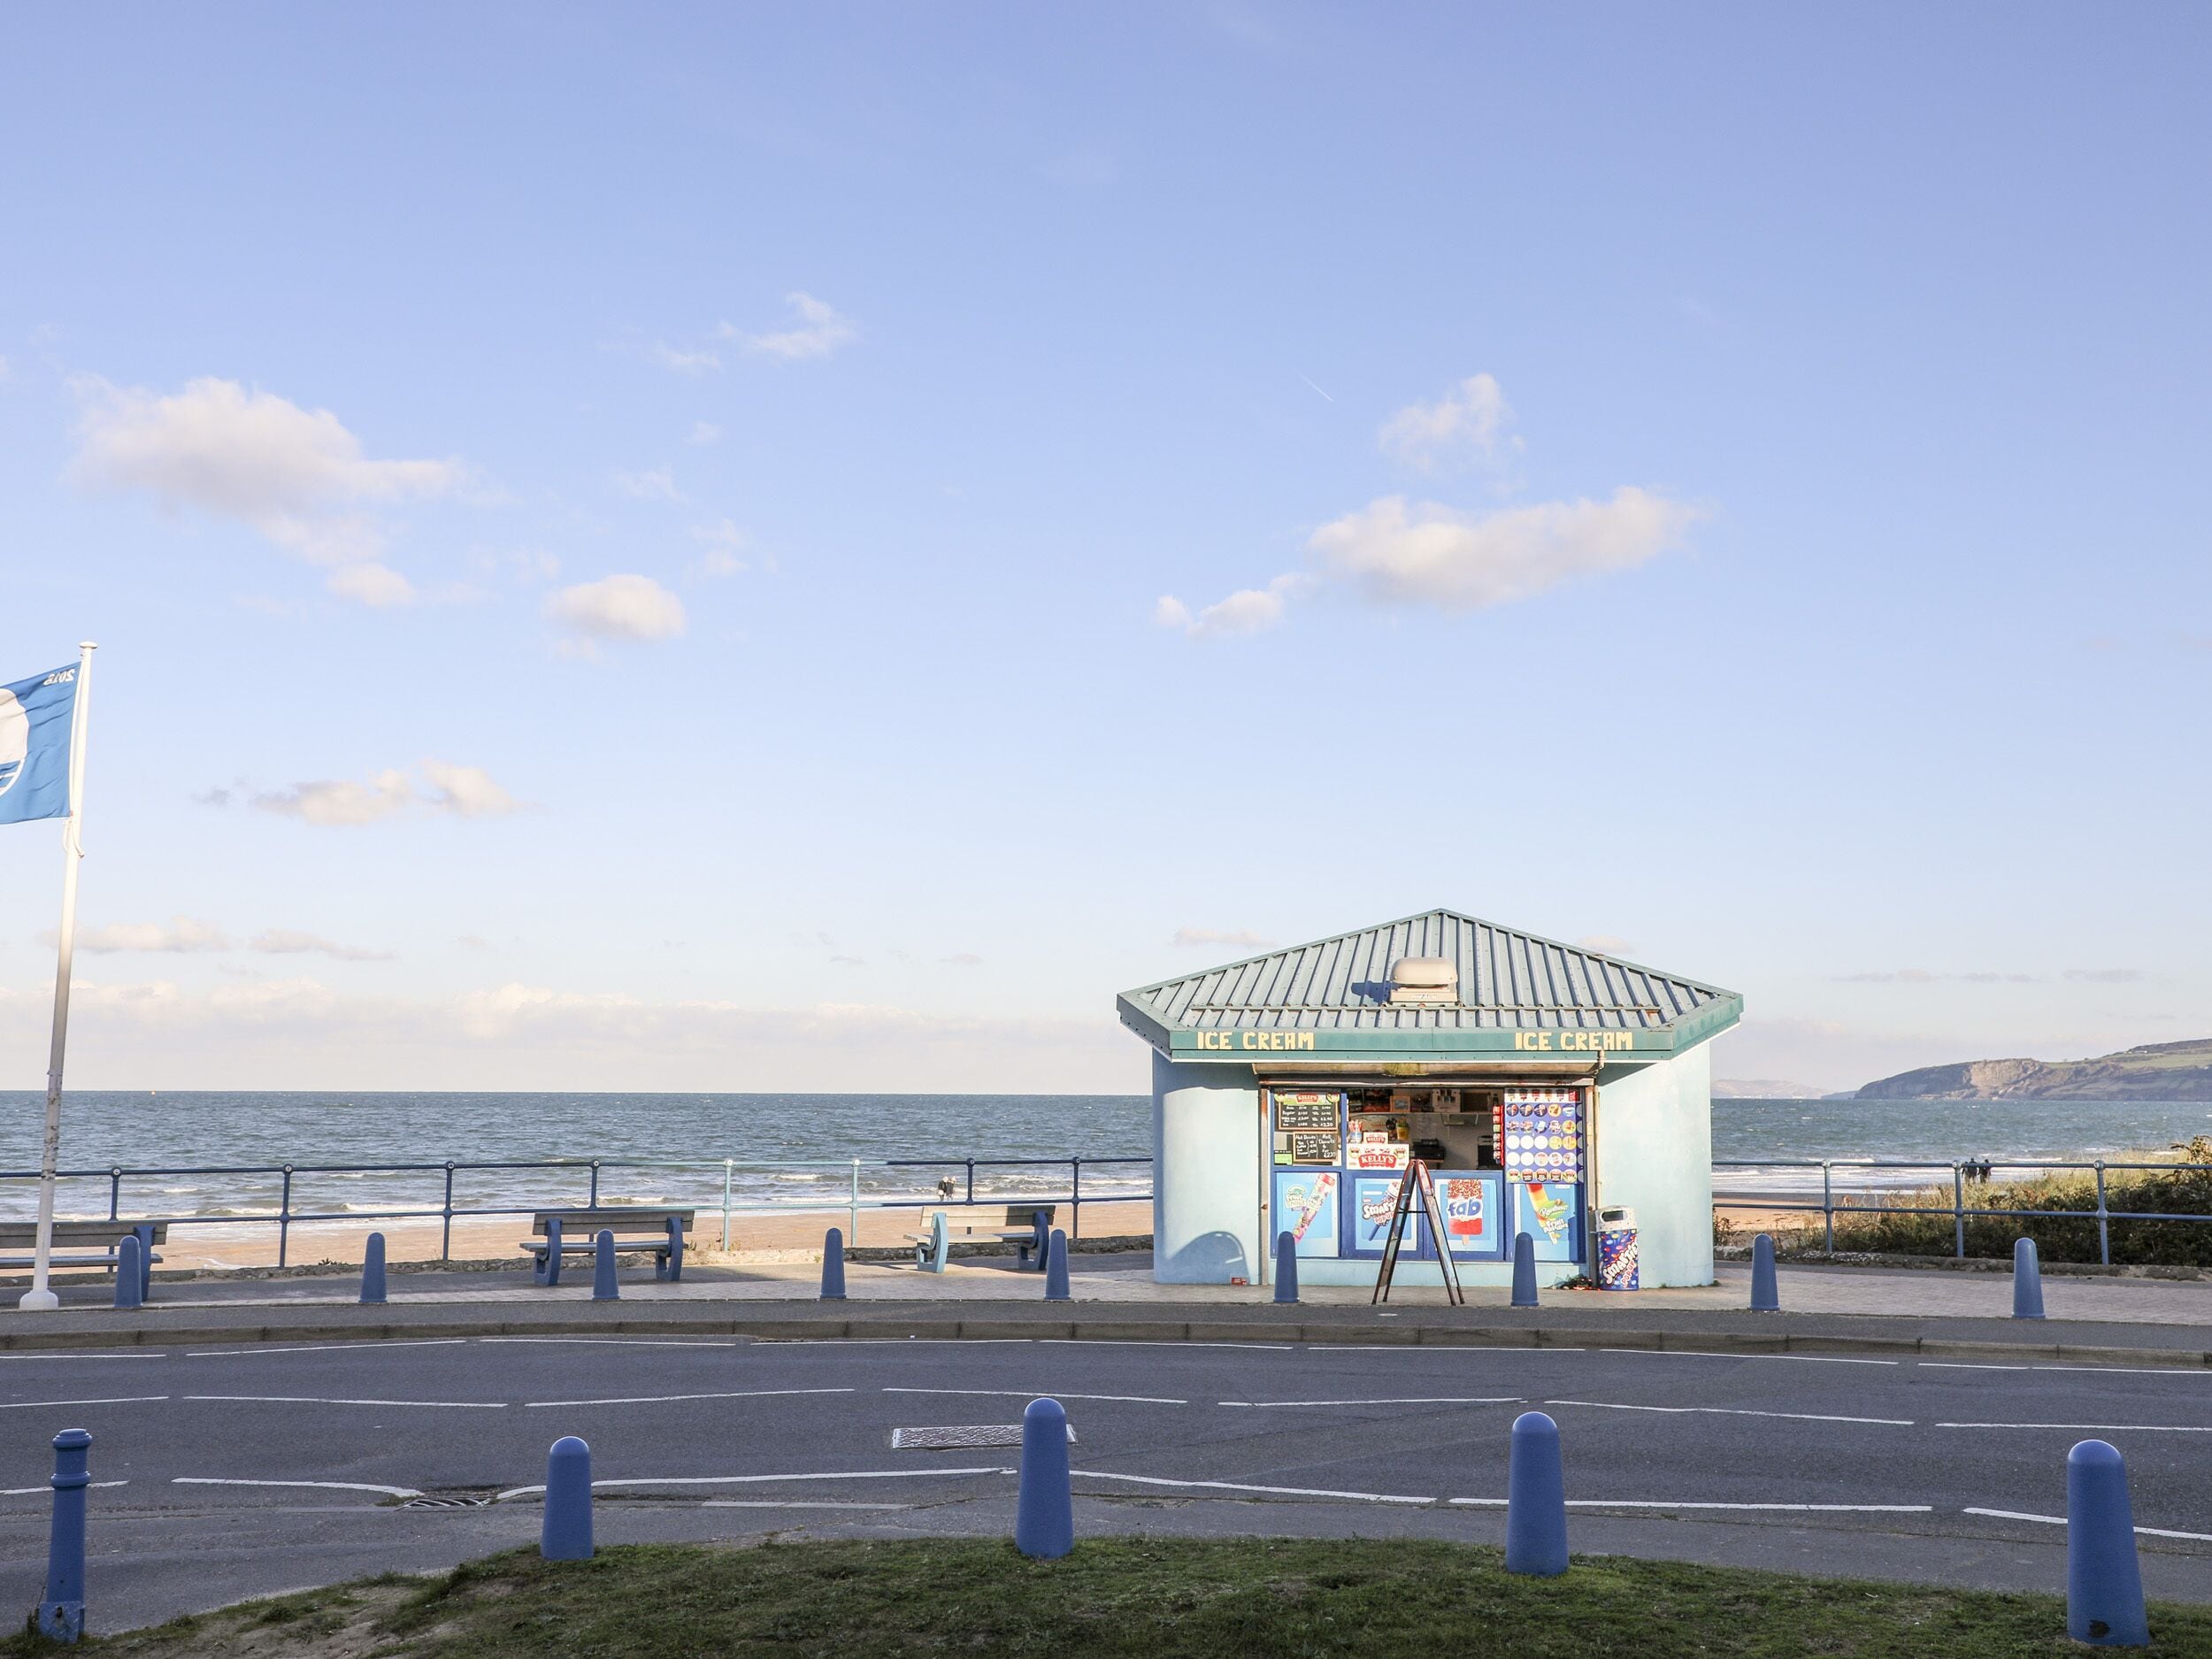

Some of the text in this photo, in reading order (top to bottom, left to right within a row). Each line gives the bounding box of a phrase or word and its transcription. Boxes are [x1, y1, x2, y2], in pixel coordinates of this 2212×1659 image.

[1197, 1031, 1314, 1050] ICE CREAM
[1515, 1032, 1632, 1050] ICE CREAM
[1363, 1201, 1397, 1219] SMART
[1448, 1197, 1481, 1216] fab
